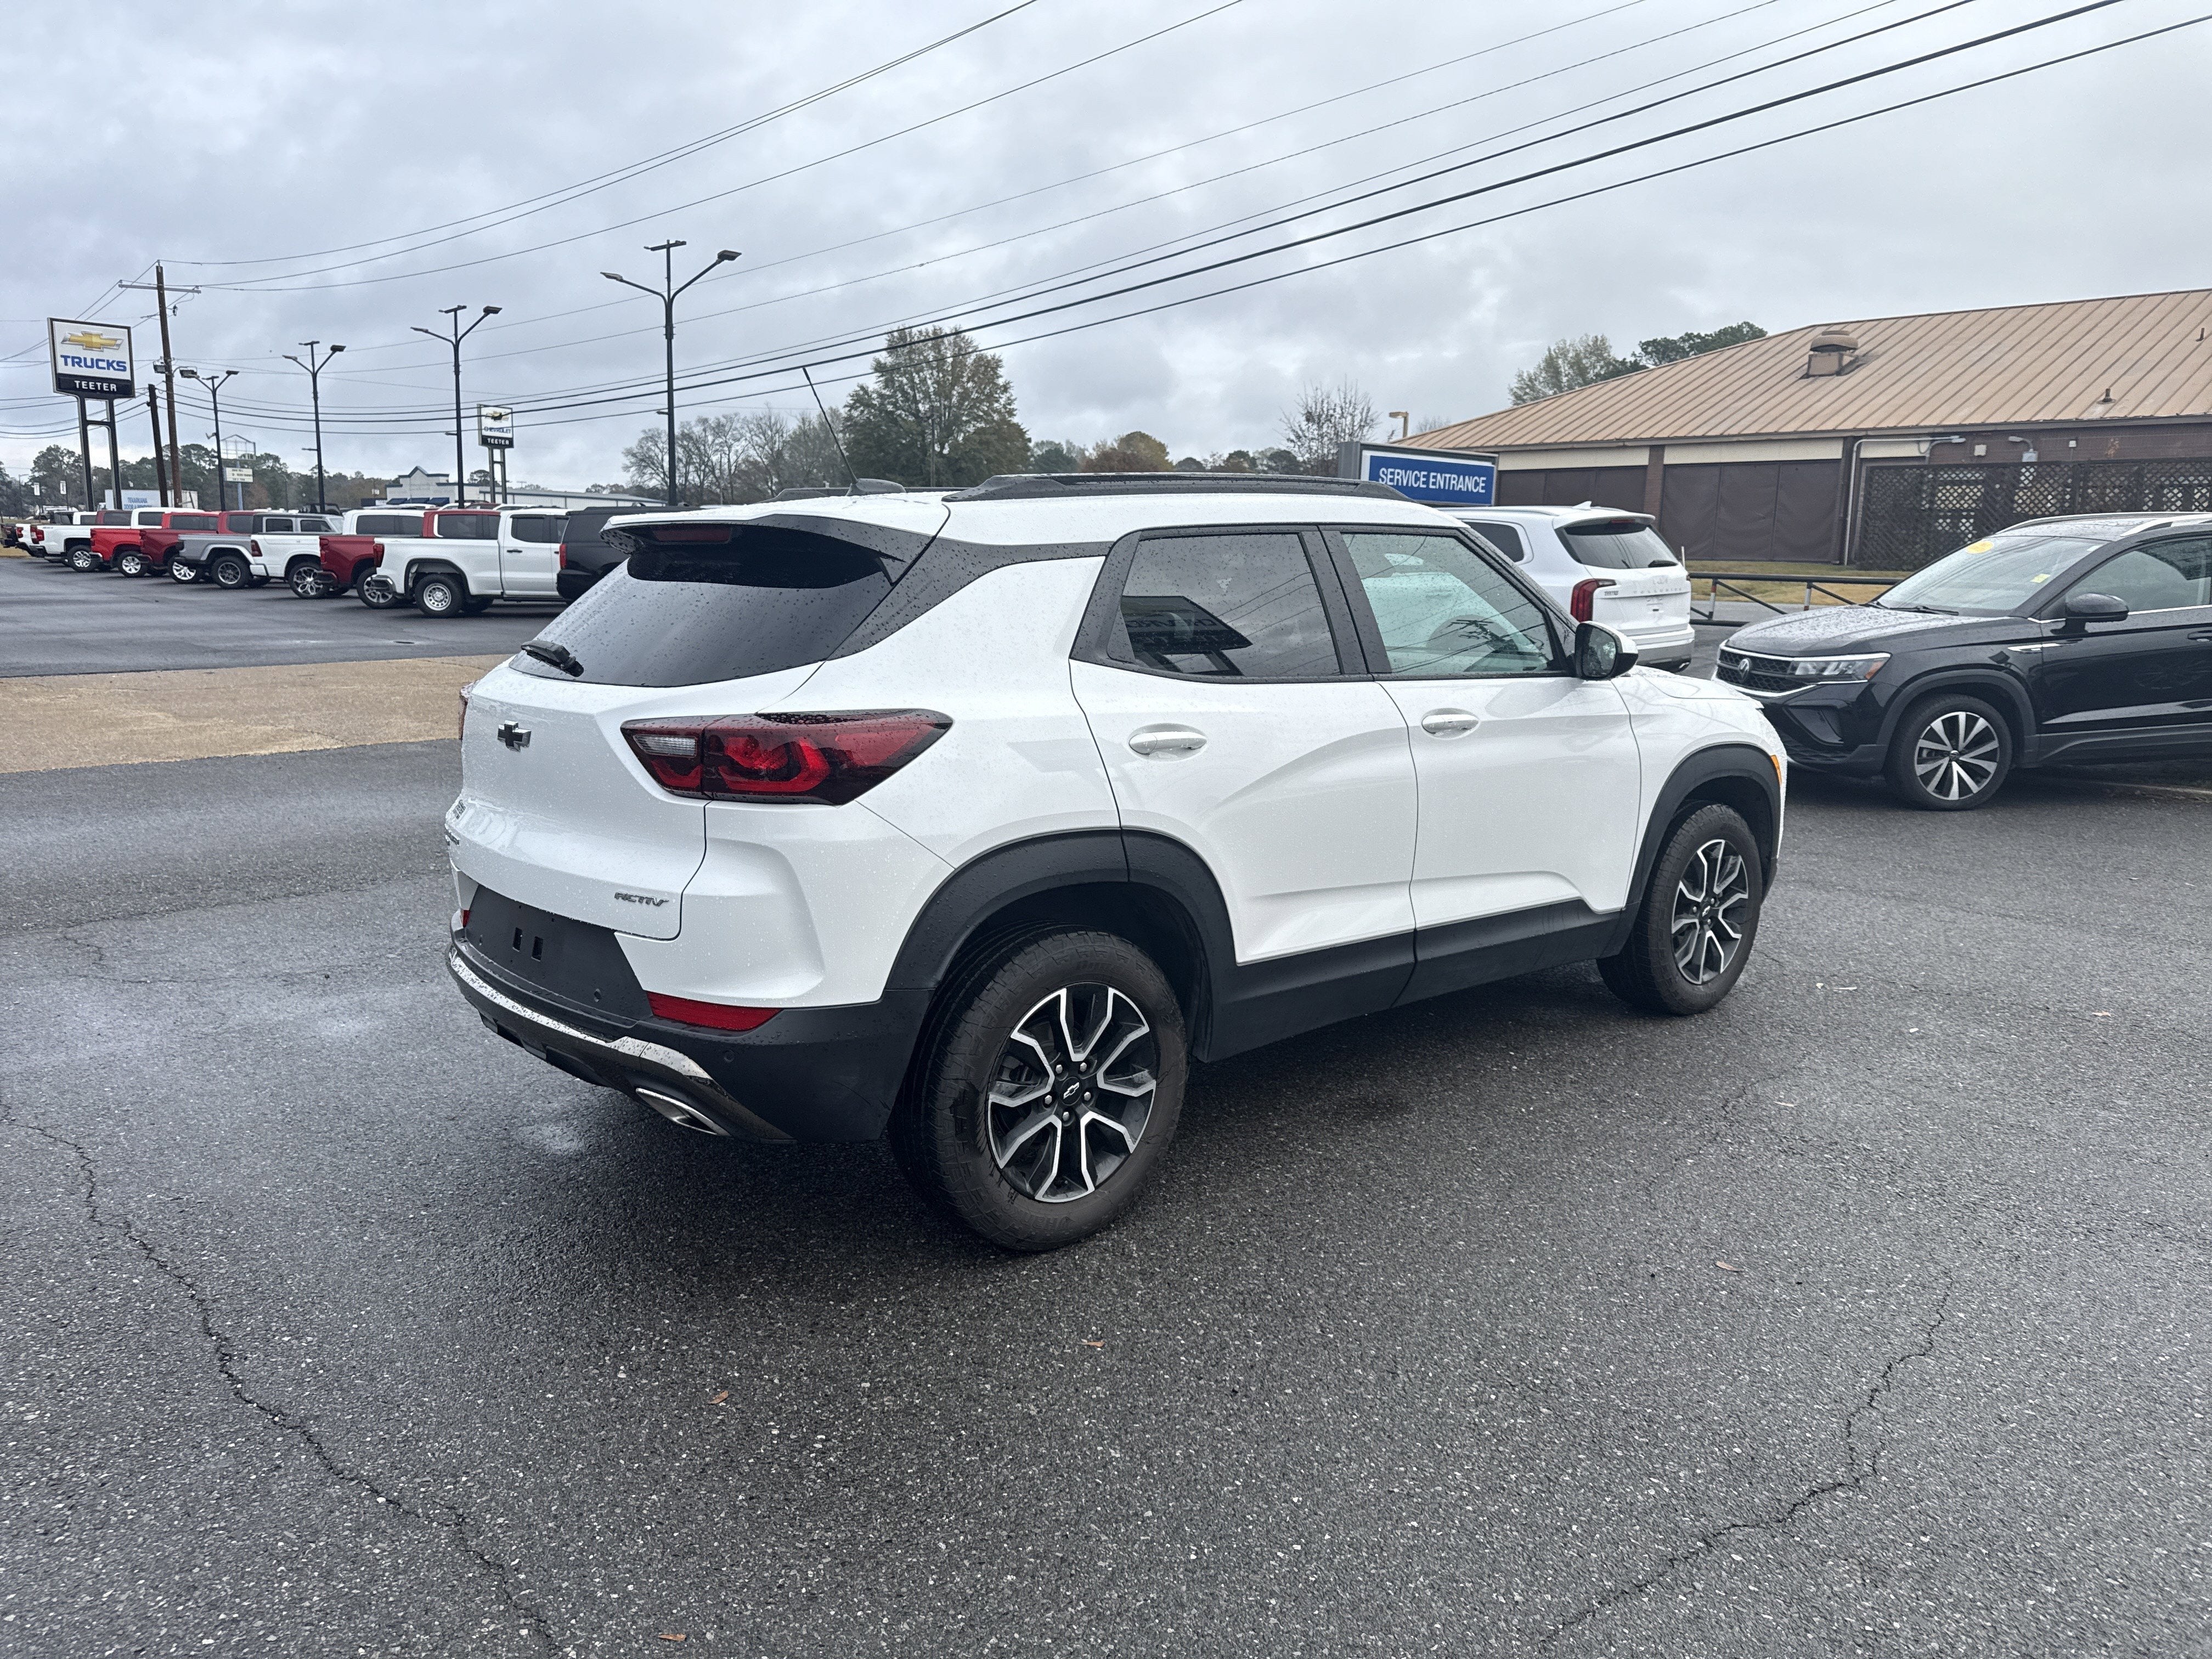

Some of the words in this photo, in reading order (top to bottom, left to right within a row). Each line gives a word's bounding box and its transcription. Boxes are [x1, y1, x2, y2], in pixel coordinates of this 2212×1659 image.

[60, 354, 127, 372] TRUCKS
[74, 380, 117, 392] TEETER
[1379, 467, 1427, 488] SERVICE
[1429, 472, 1486, 493] ENTRANCE
[614, 892, 669, 907] ACTIV
